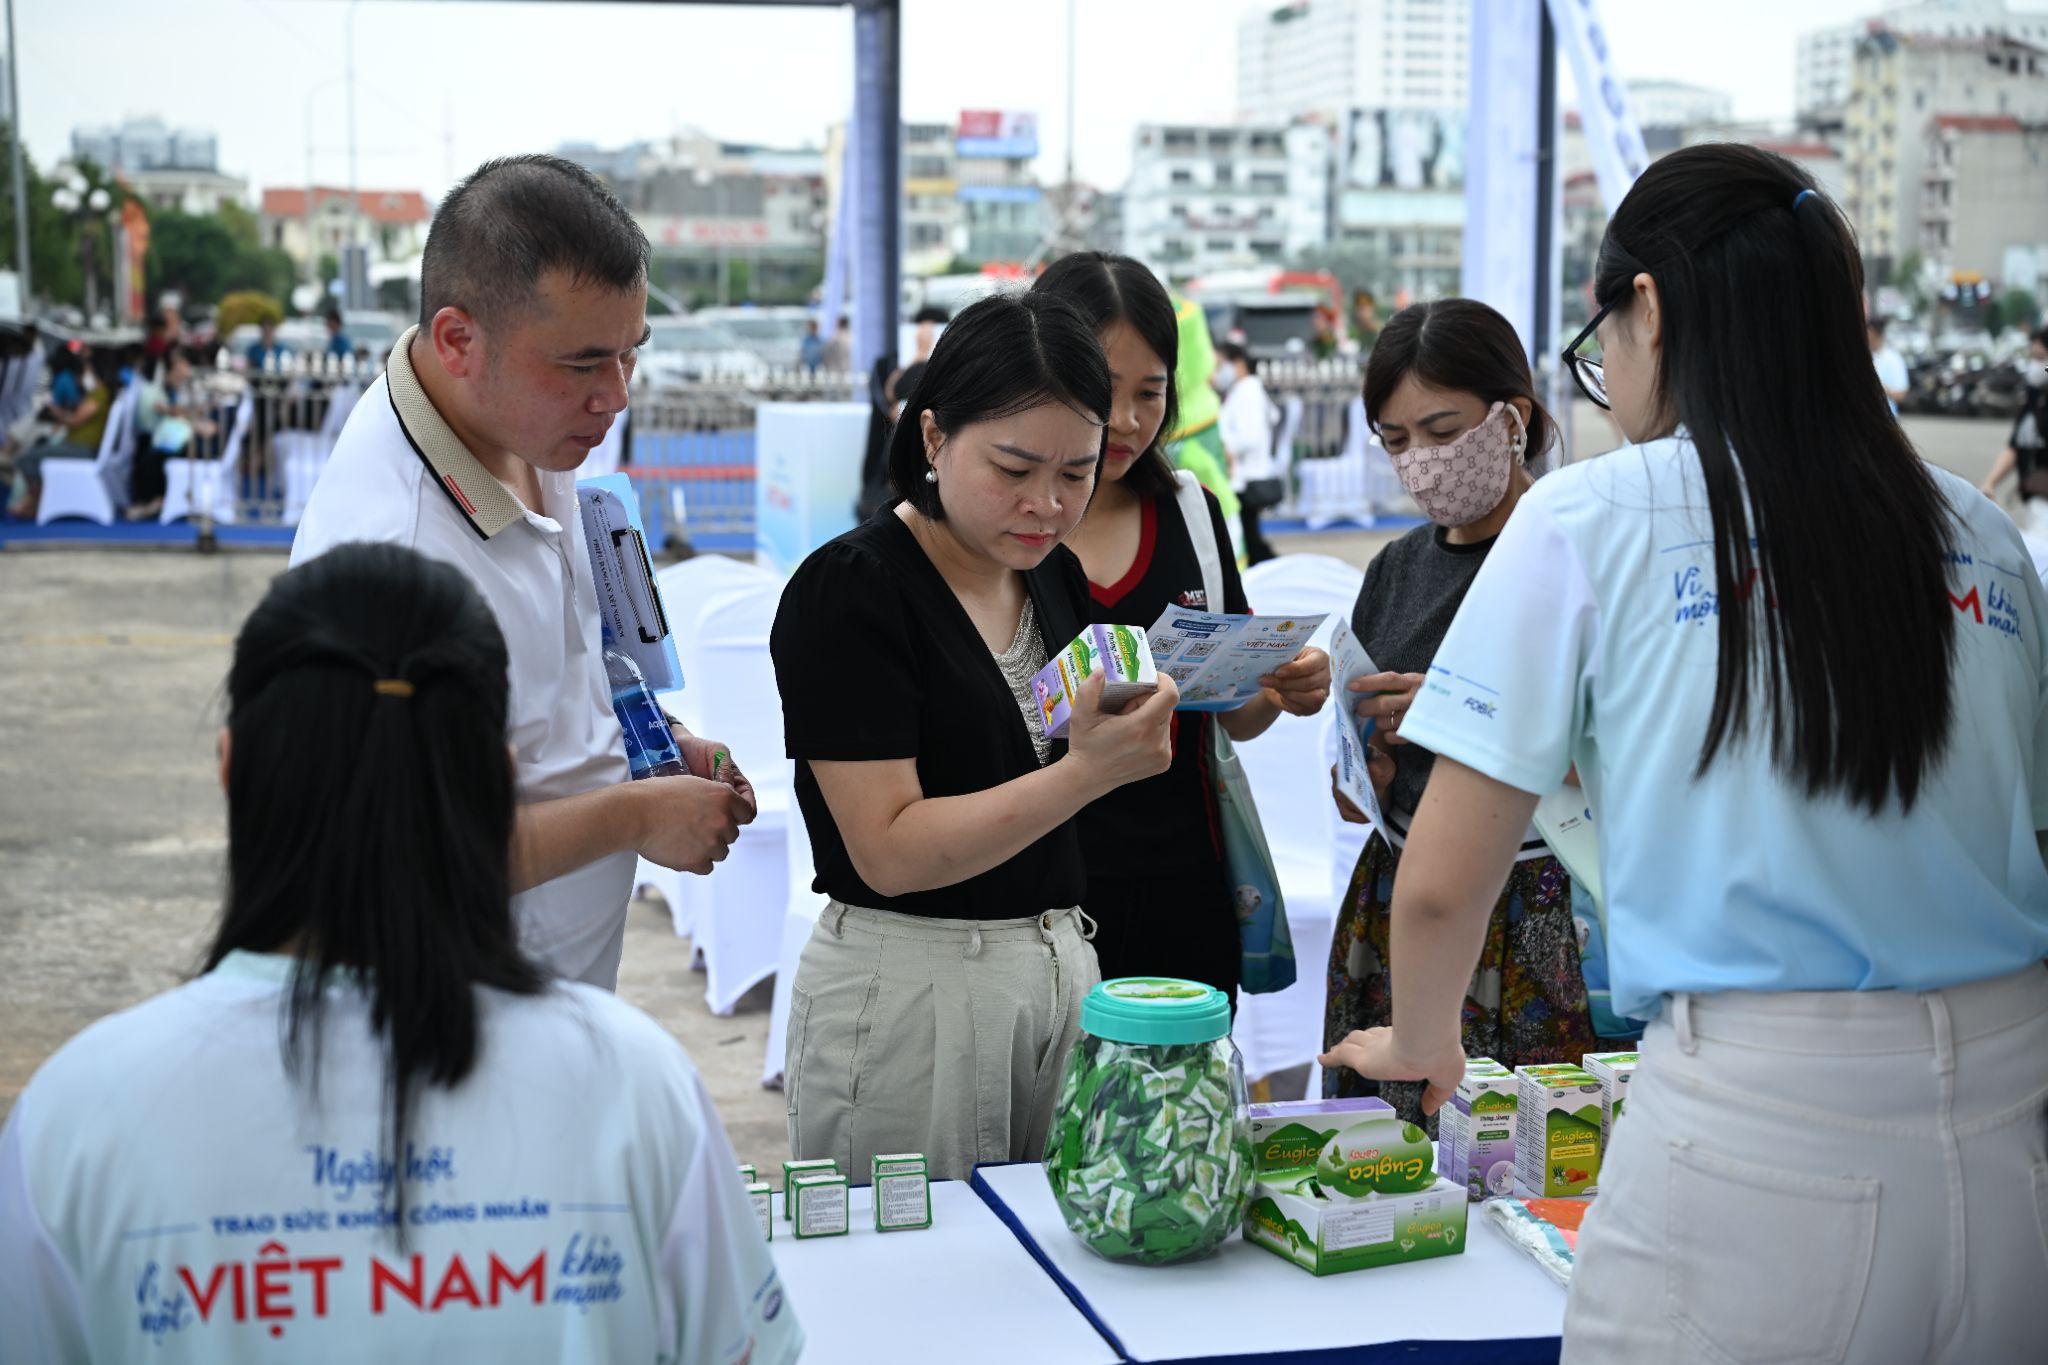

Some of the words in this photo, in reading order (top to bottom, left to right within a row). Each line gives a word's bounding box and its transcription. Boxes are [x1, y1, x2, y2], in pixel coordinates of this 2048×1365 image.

[1551, 1130, 1594, 1144] Eugica
[1349, 1148, 1380, 1162] Candy
[1349, 1156, 1424, 1183] Eugica
[211, 1213, 277, 1235] TRAO
[176, 1239, 344, 1339] VIỆT
[369, 1247, 548, 1316] NAM
